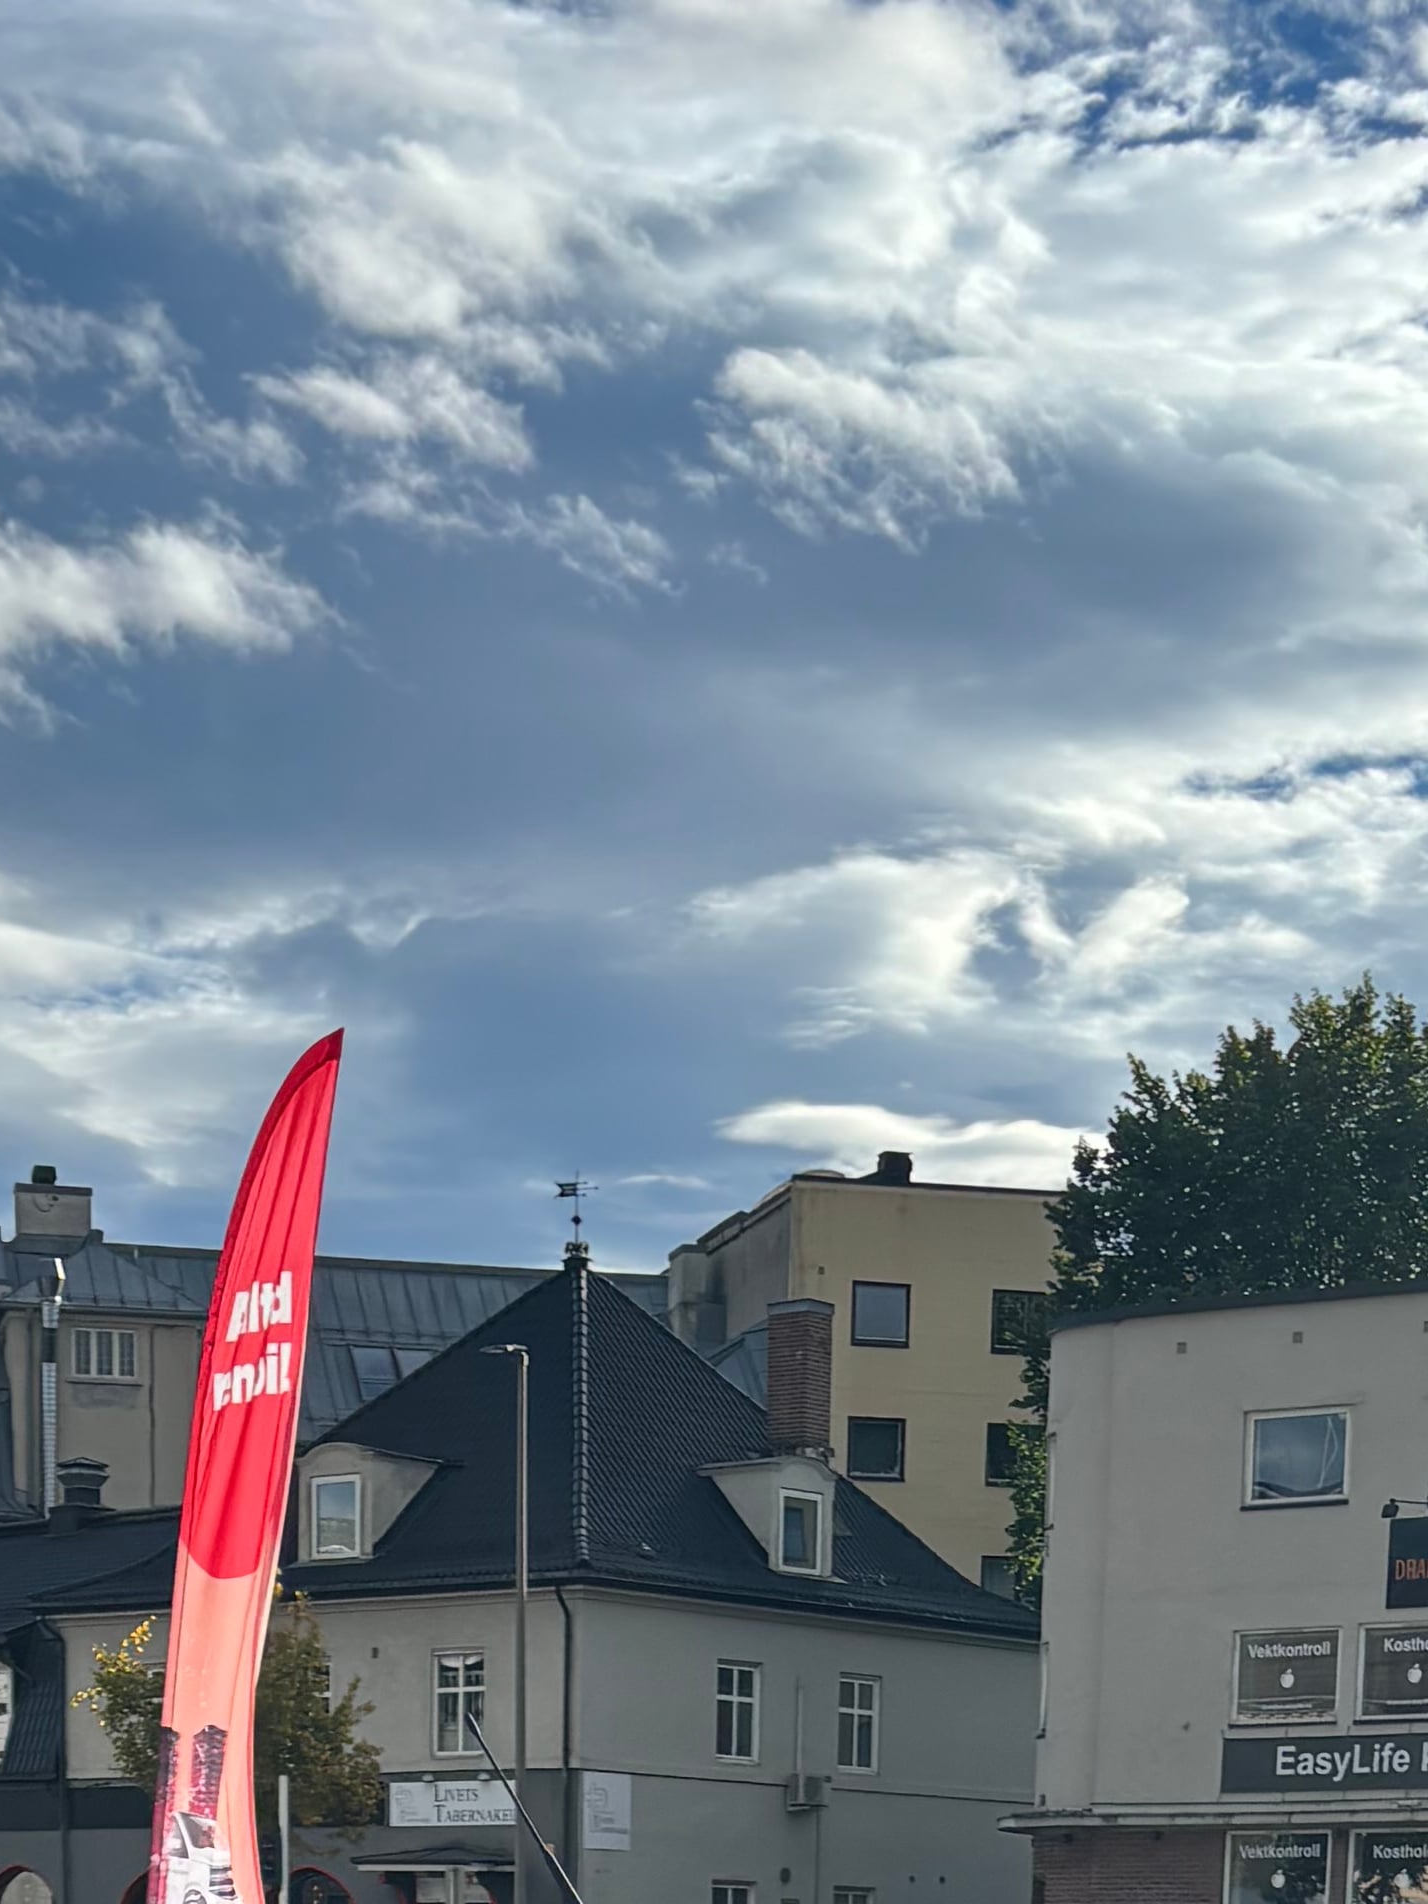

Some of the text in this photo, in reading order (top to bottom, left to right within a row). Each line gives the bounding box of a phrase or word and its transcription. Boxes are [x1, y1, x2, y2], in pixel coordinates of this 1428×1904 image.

[1248, 1641, 1330, 1658] Vektkontroll
[1276, 1742, 1410, 1782] EasyLife
[1239, 1844, 1320, 1859] Vektkontroll
